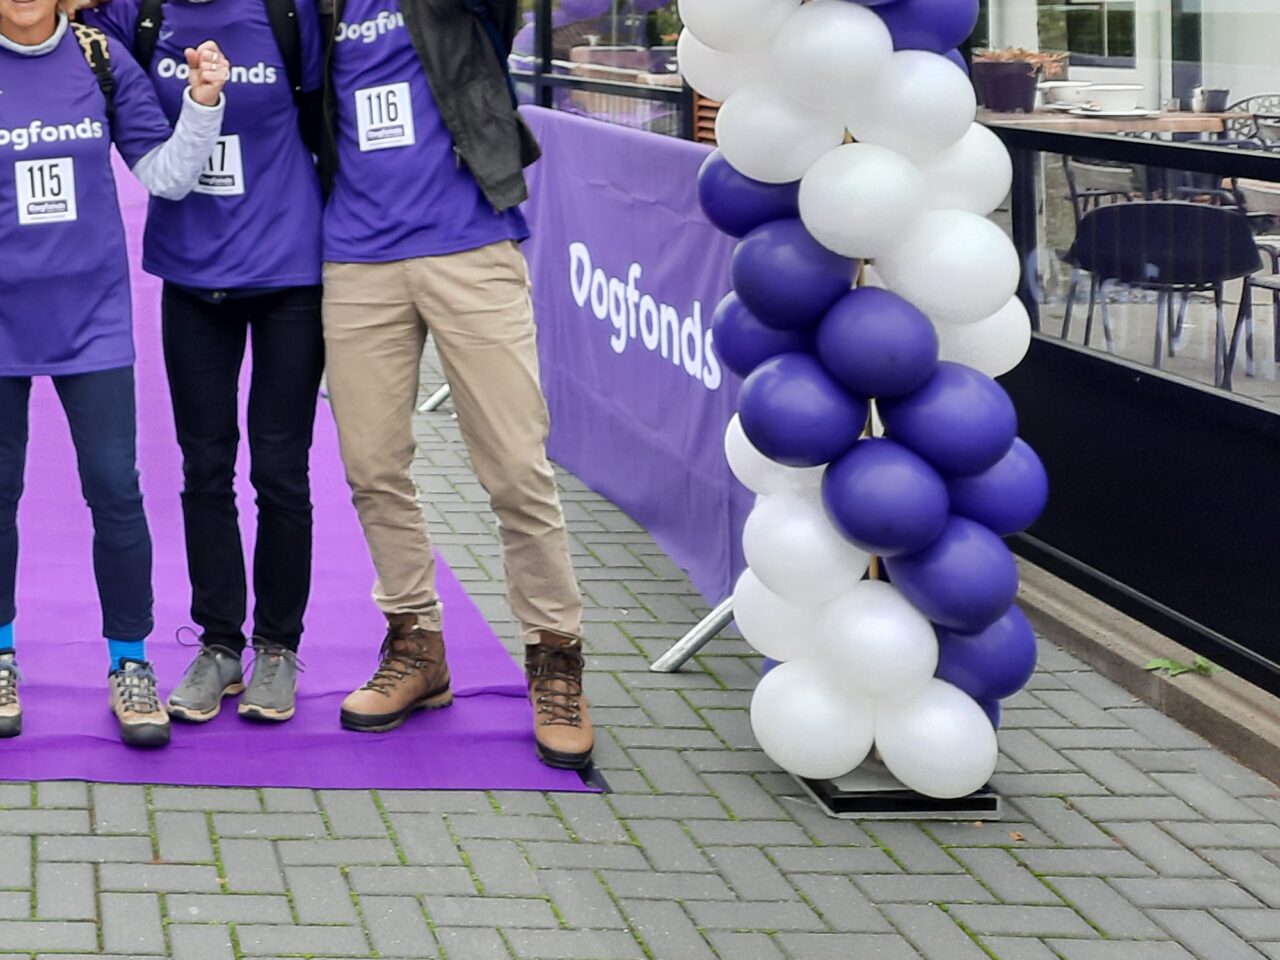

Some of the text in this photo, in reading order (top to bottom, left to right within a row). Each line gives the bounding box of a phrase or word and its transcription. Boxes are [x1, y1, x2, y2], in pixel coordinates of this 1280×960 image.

[335, 10, 404, 43] Oogfo
[157, 58, 277, 83] Oonds
[367, 90, 398, 125] 116
[27, 163, 61, 198] 115
[569, 241, 721, 390] Oogfonds
